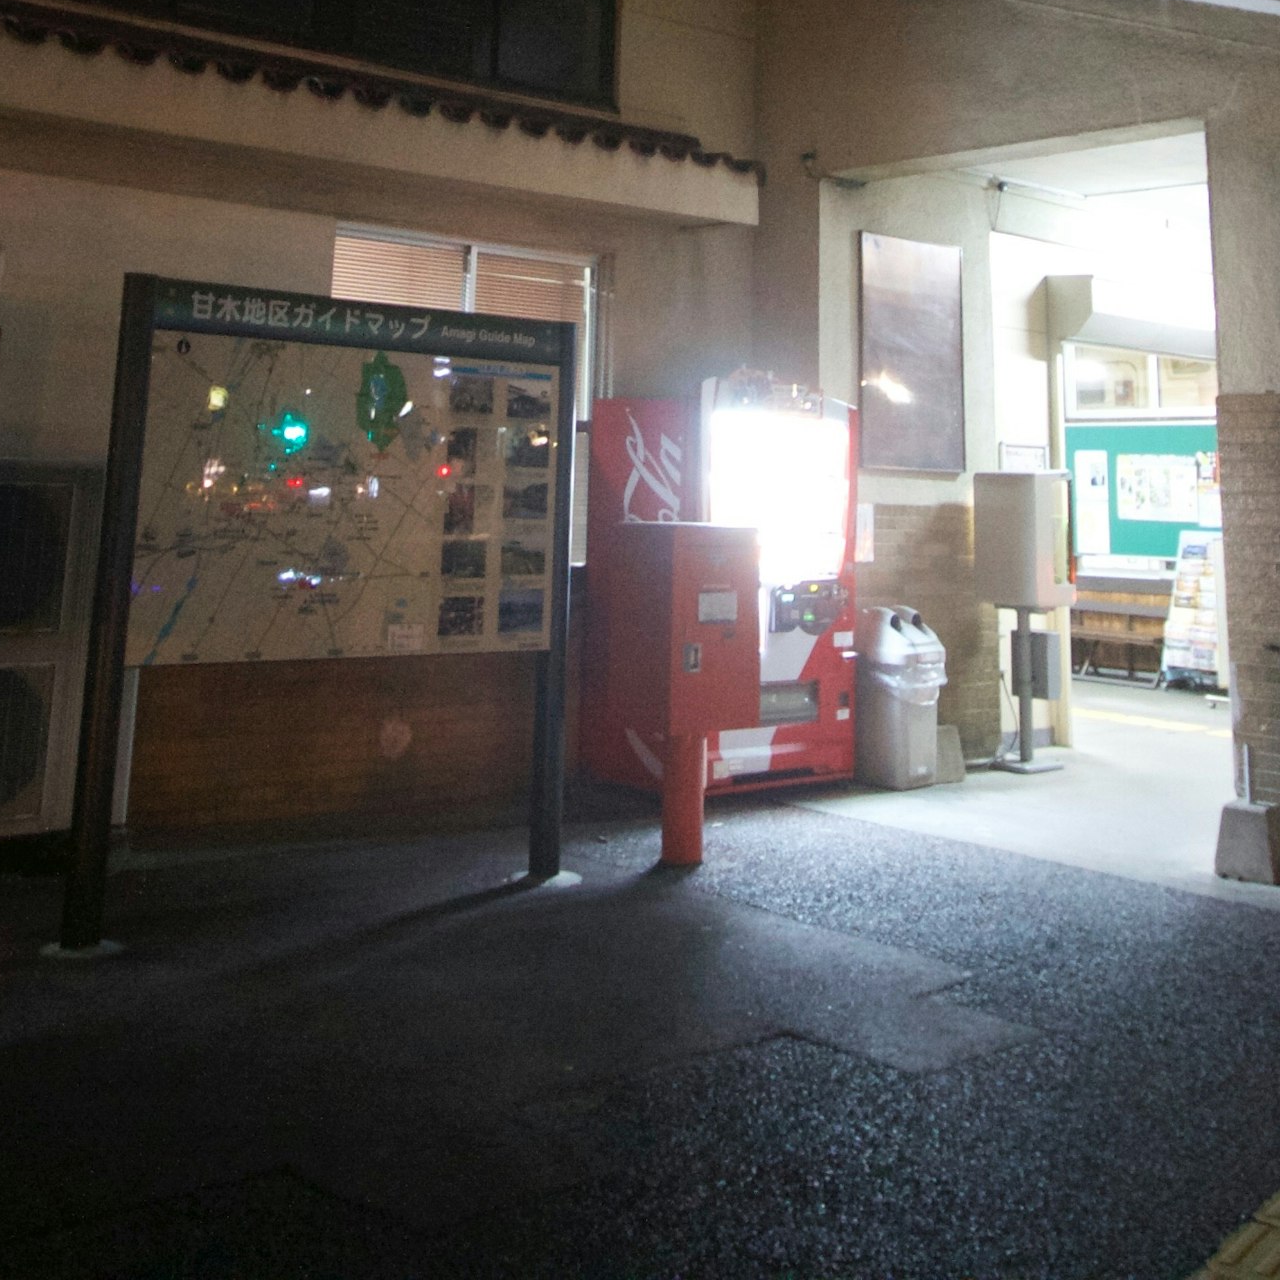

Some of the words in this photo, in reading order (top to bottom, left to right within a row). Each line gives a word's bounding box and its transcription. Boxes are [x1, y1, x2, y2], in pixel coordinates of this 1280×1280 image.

[191, 290, 433, 340] 甘木地区ガイドマップ
[441, 325, 476, 343] Amagi
[479, 329, 511, 343] Guide
[513, 332, 536, 348] Map
